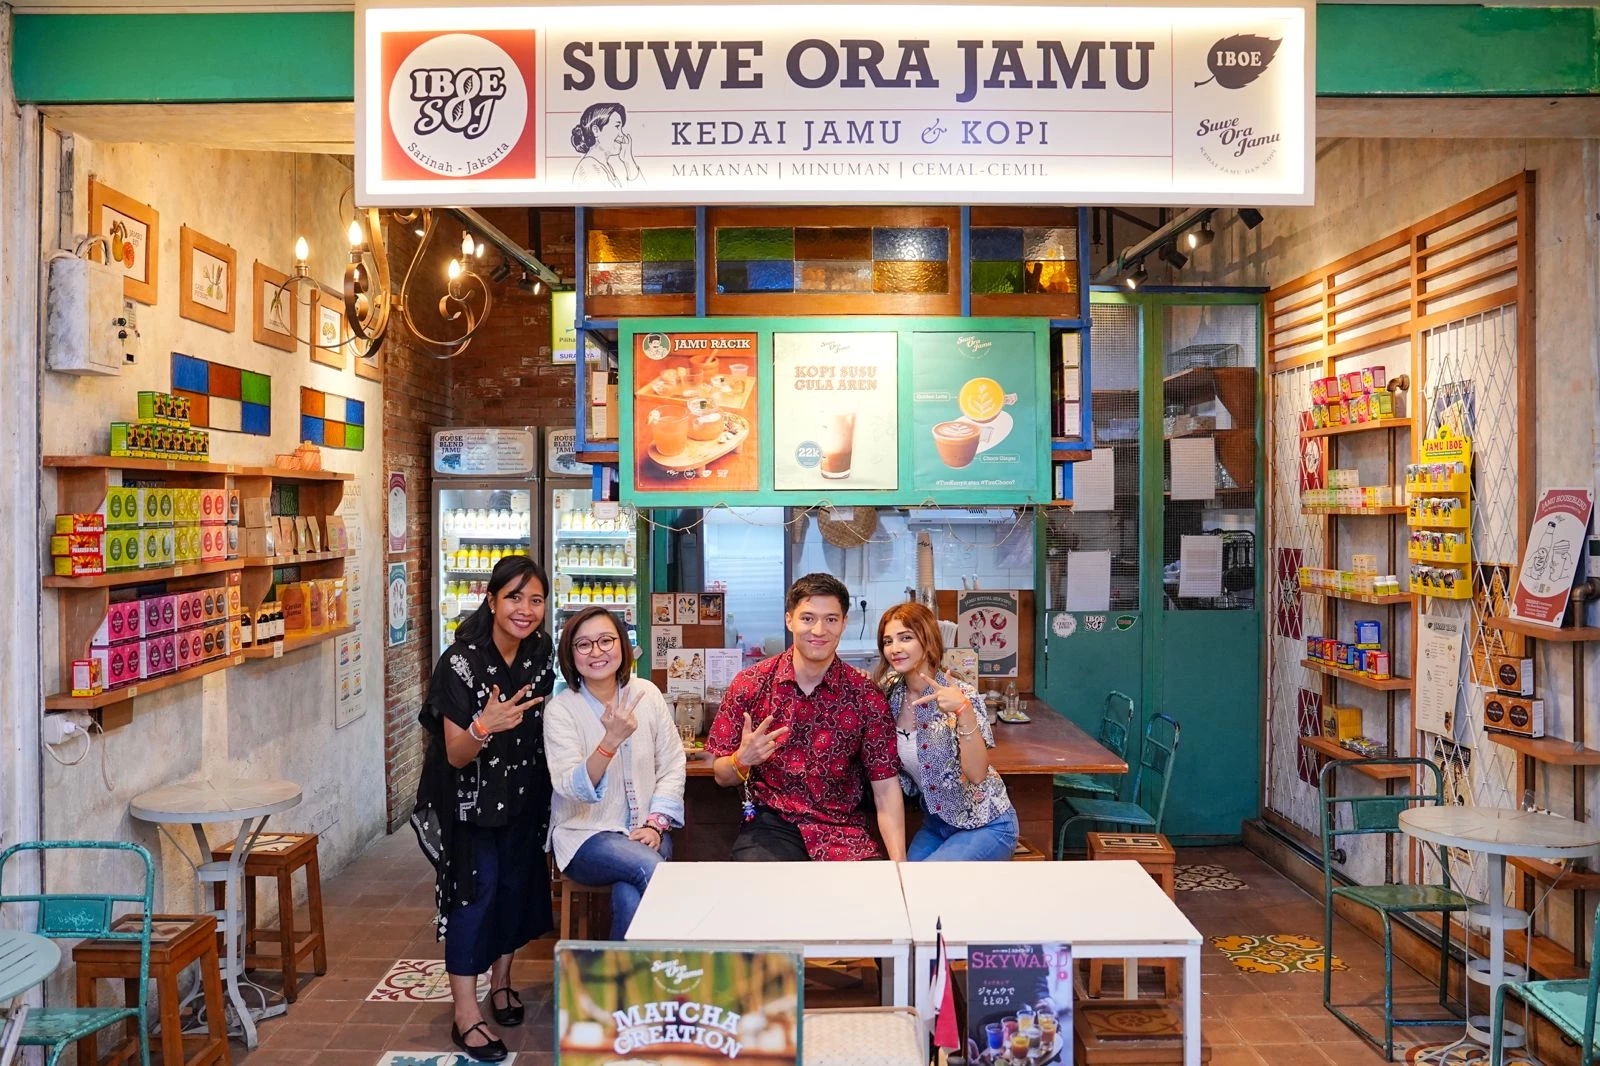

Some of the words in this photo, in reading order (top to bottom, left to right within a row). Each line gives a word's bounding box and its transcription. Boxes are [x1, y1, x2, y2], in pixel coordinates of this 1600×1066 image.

[1216, 51, 1262, 67] IBOE
[562, 39, 764, 91] SUWE
[785, 38, 940, 89] ORA
[955, 39, 1156, 103] JAMU
[410, 67, 507, 102] IBOE
[671, 120, 787, 146] KEDAI
[802, 119, 902, 151] JAMU
[920, 117, 948, 145] &
[961, 120, 1049, 145] KOPI
[1196, 117, 1240, 137] Suwe
[1219, 126, 1254, 146] Ora
[1233, 132, 1282, 157] Jamu
[407, 142, 453, 173] Sarinah
[466, 142, 510, 174] Jakarta
[671, 161, 770, 178] MAKANAN
[791, 162, 891, 178] MINUMAN
[912, 161, 1049, 178] CEMAL-CEMIL
[674, 339, 708, 350] JAMU
[710, 339, 751, 349] RACIK
[794, 366, 836, 378] KOPI
[839, 366, 877, 378] SUSU
[794, 379, 834, 391] GULA
[836, 379, 878, 391] AREN
[441, 447, 462, 455] JAMU
[1425, 441, 1444, 452] JAMU
[1446, 439, 1463, 450] IBOE
[1084, 615, 1106, 623] IBOE
[971, 950, 1068, 969] SKYWARD
[978, 986, 1016, 996] ジャムウで
[983, 996, 1011, 1006] ととのう
[612, 1001, 742, 1035] MATCHA
[613, 1024, 744, 1060] CREATION
